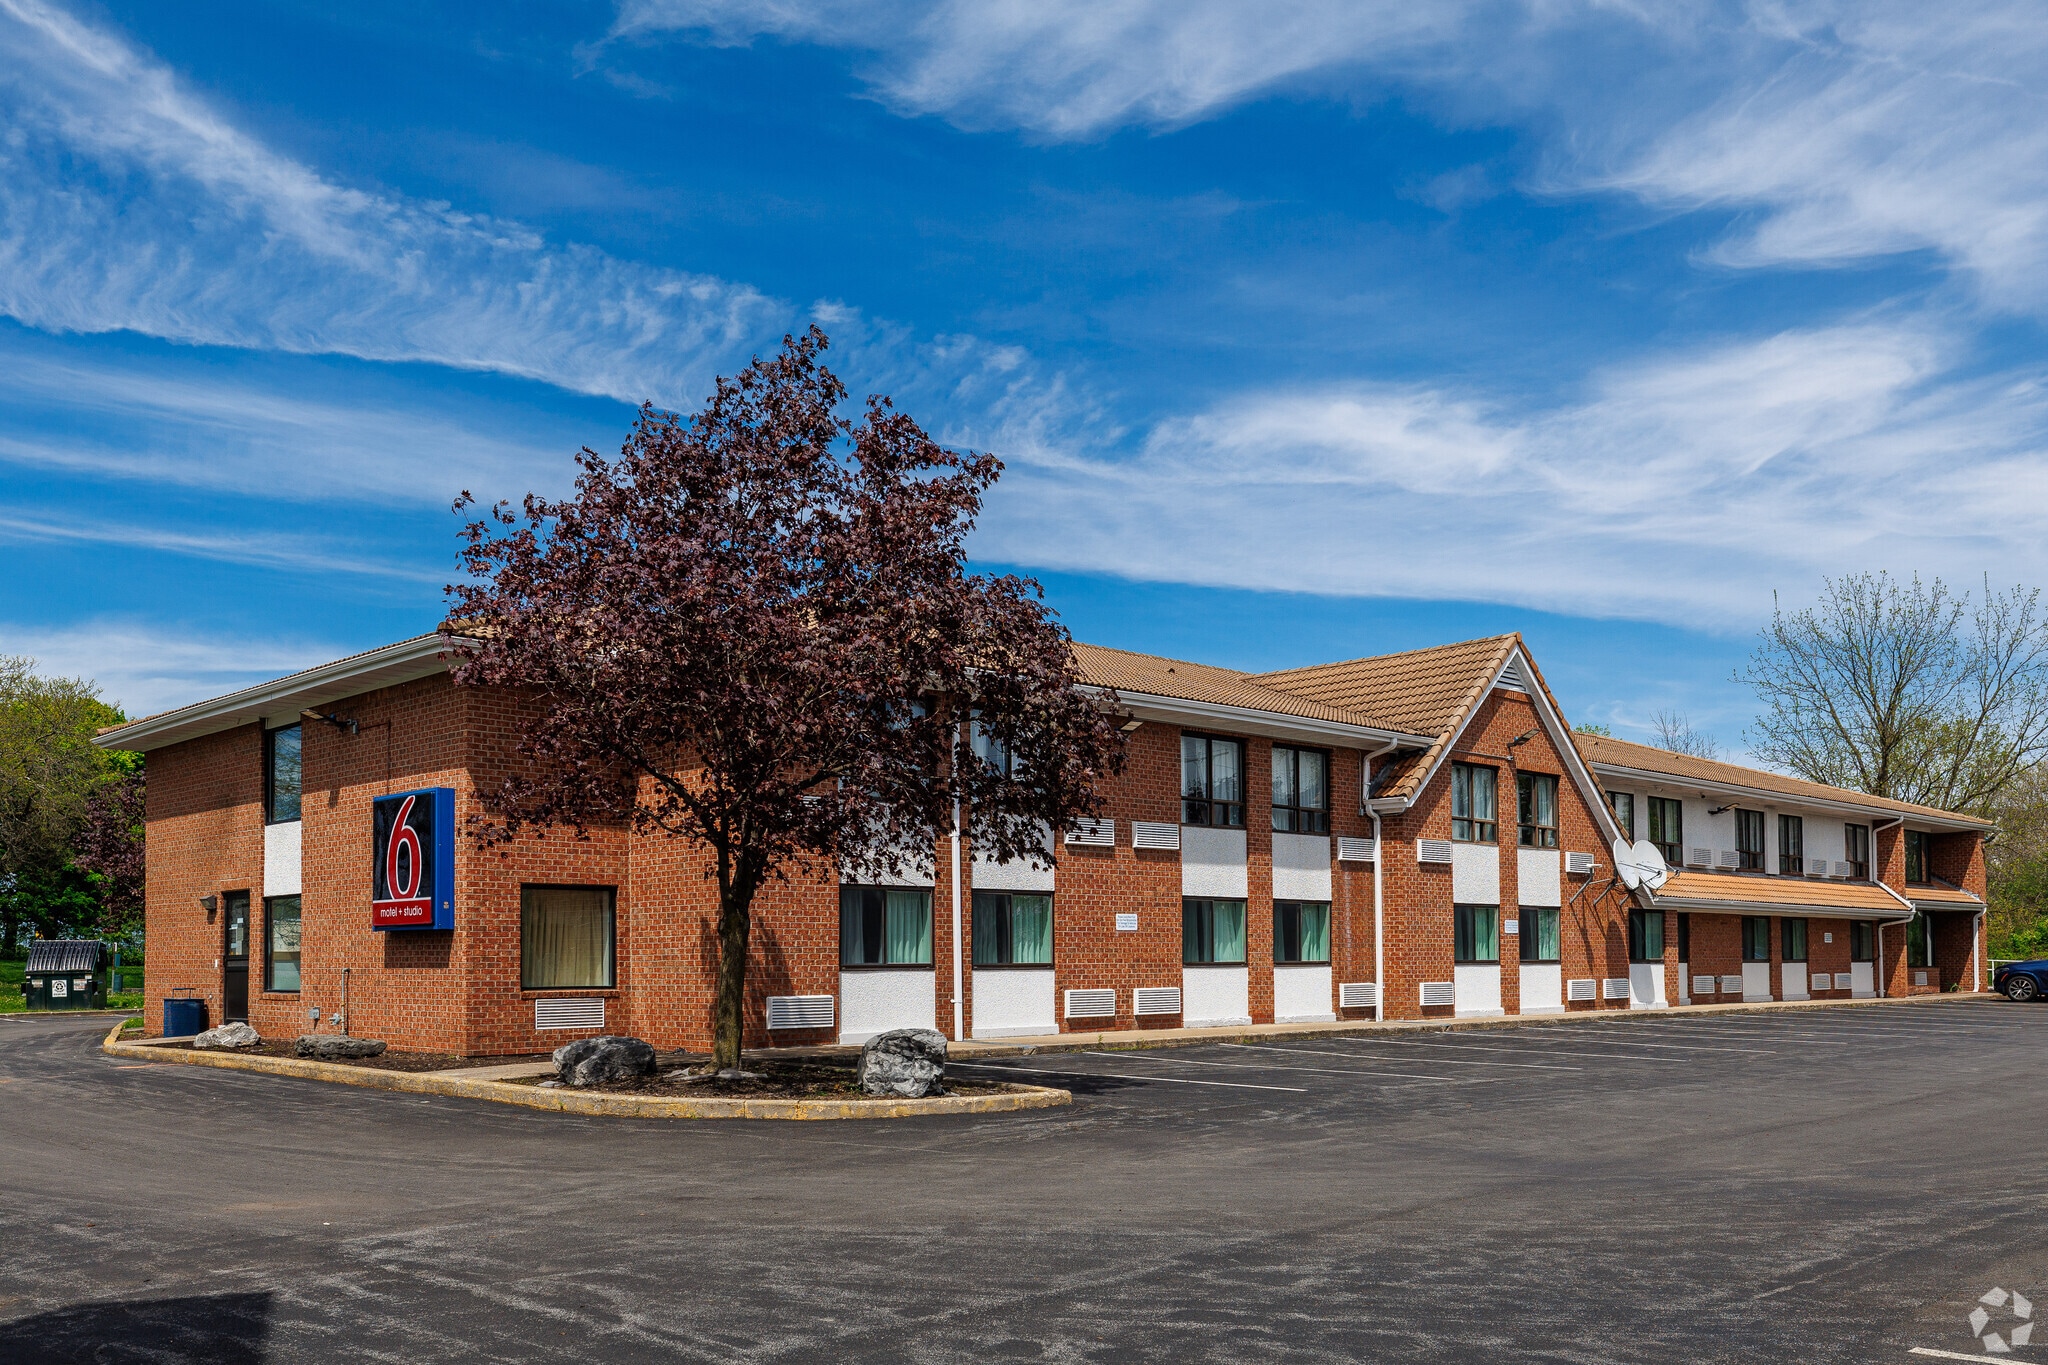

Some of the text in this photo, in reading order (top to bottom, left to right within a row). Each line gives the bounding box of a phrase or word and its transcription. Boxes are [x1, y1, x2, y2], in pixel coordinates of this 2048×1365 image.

[386, 795, 422, 900] 6
[380, 906, 398, 918] motel
[404, 905, 422, 916] studio
